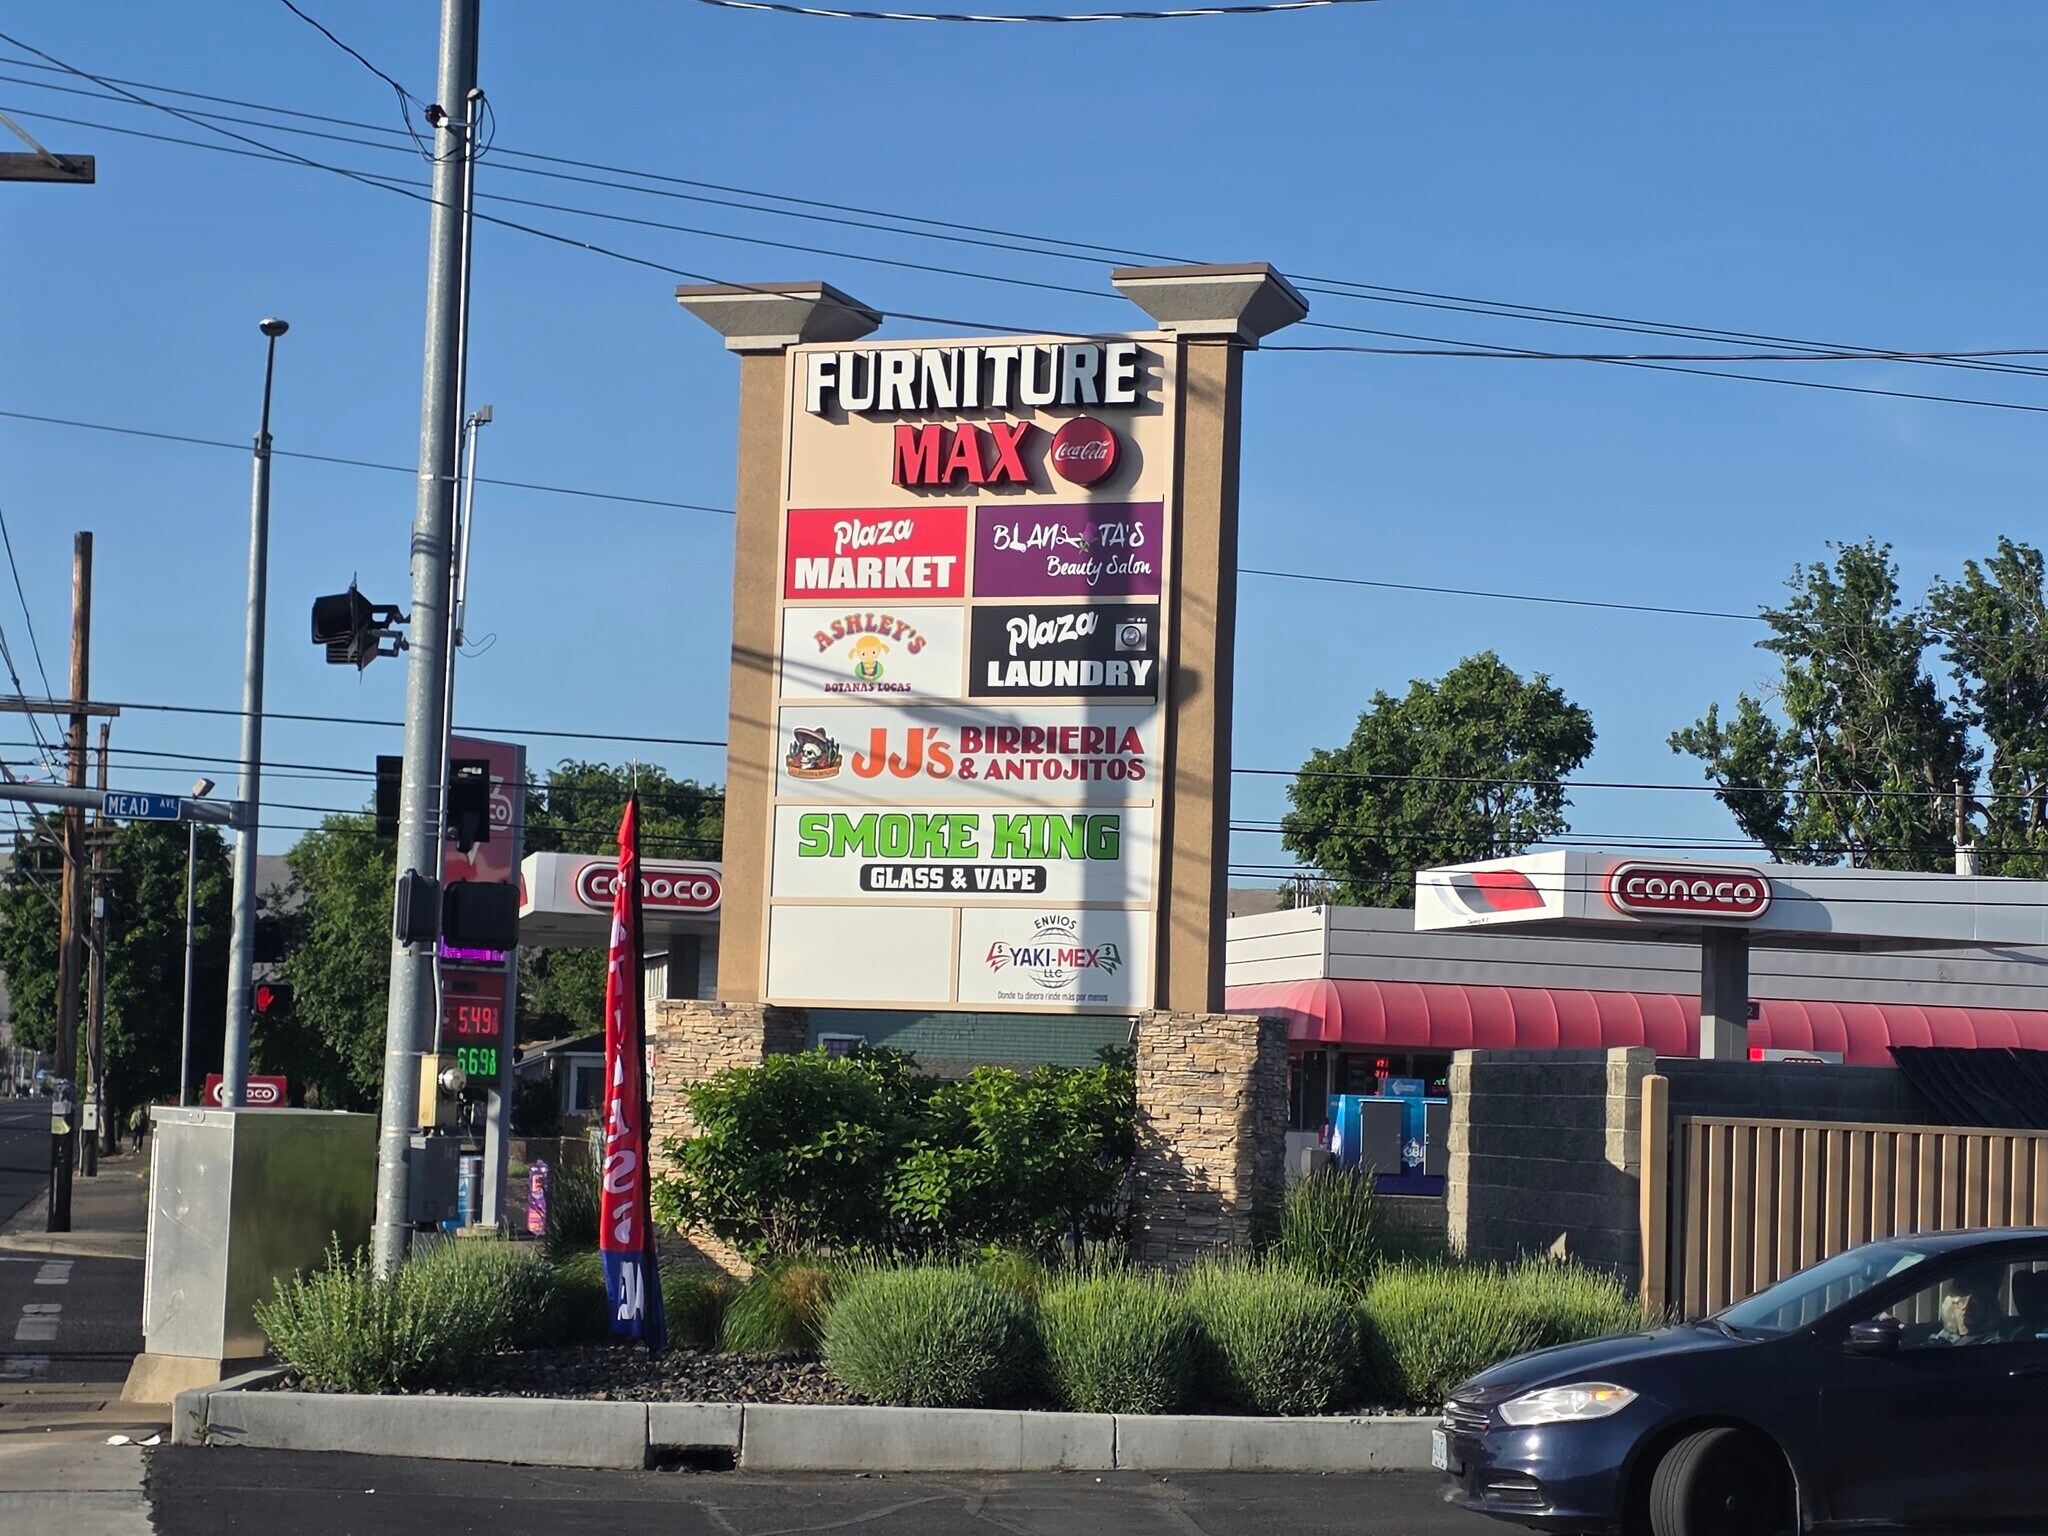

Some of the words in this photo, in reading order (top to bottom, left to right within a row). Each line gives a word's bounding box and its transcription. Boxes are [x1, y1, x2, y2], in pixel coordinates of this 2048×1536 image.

[805, 343, 1137, 412] FURNITURE
[892, 421, 1031, 485] MAX
[794, 555, 957, 590] MARKET
[1047, 555, 1102, 586] Beauty
[1106, 553, 1152, 575] Salon
[814, 612, 927, 655] ASHLEY'S
[824, 682, 875, 692] BOTANAS
[877, 682, 912, 692] LOCAS
[987, 659, 1153, 688] LAUNDRY
[959, 726, 1145, 754] BIRRIERIA
[957, 757, 978, 781] &
[983, 757, 1146, 781] ANTOJITOS
[108, 795, 149, 816] MEAD
[799, 813, 980, 858] SMOKE
[991, 814, 1121, 860] KING
[870, 866, 945, 889] GLASS
[950, 867, 968, 889] &
[974, 867, 1036, 890] VAPE
[1034, 915, 1077, 930] ENVIOS
[1009, 947, 1100, 968] YAKI-MEX
